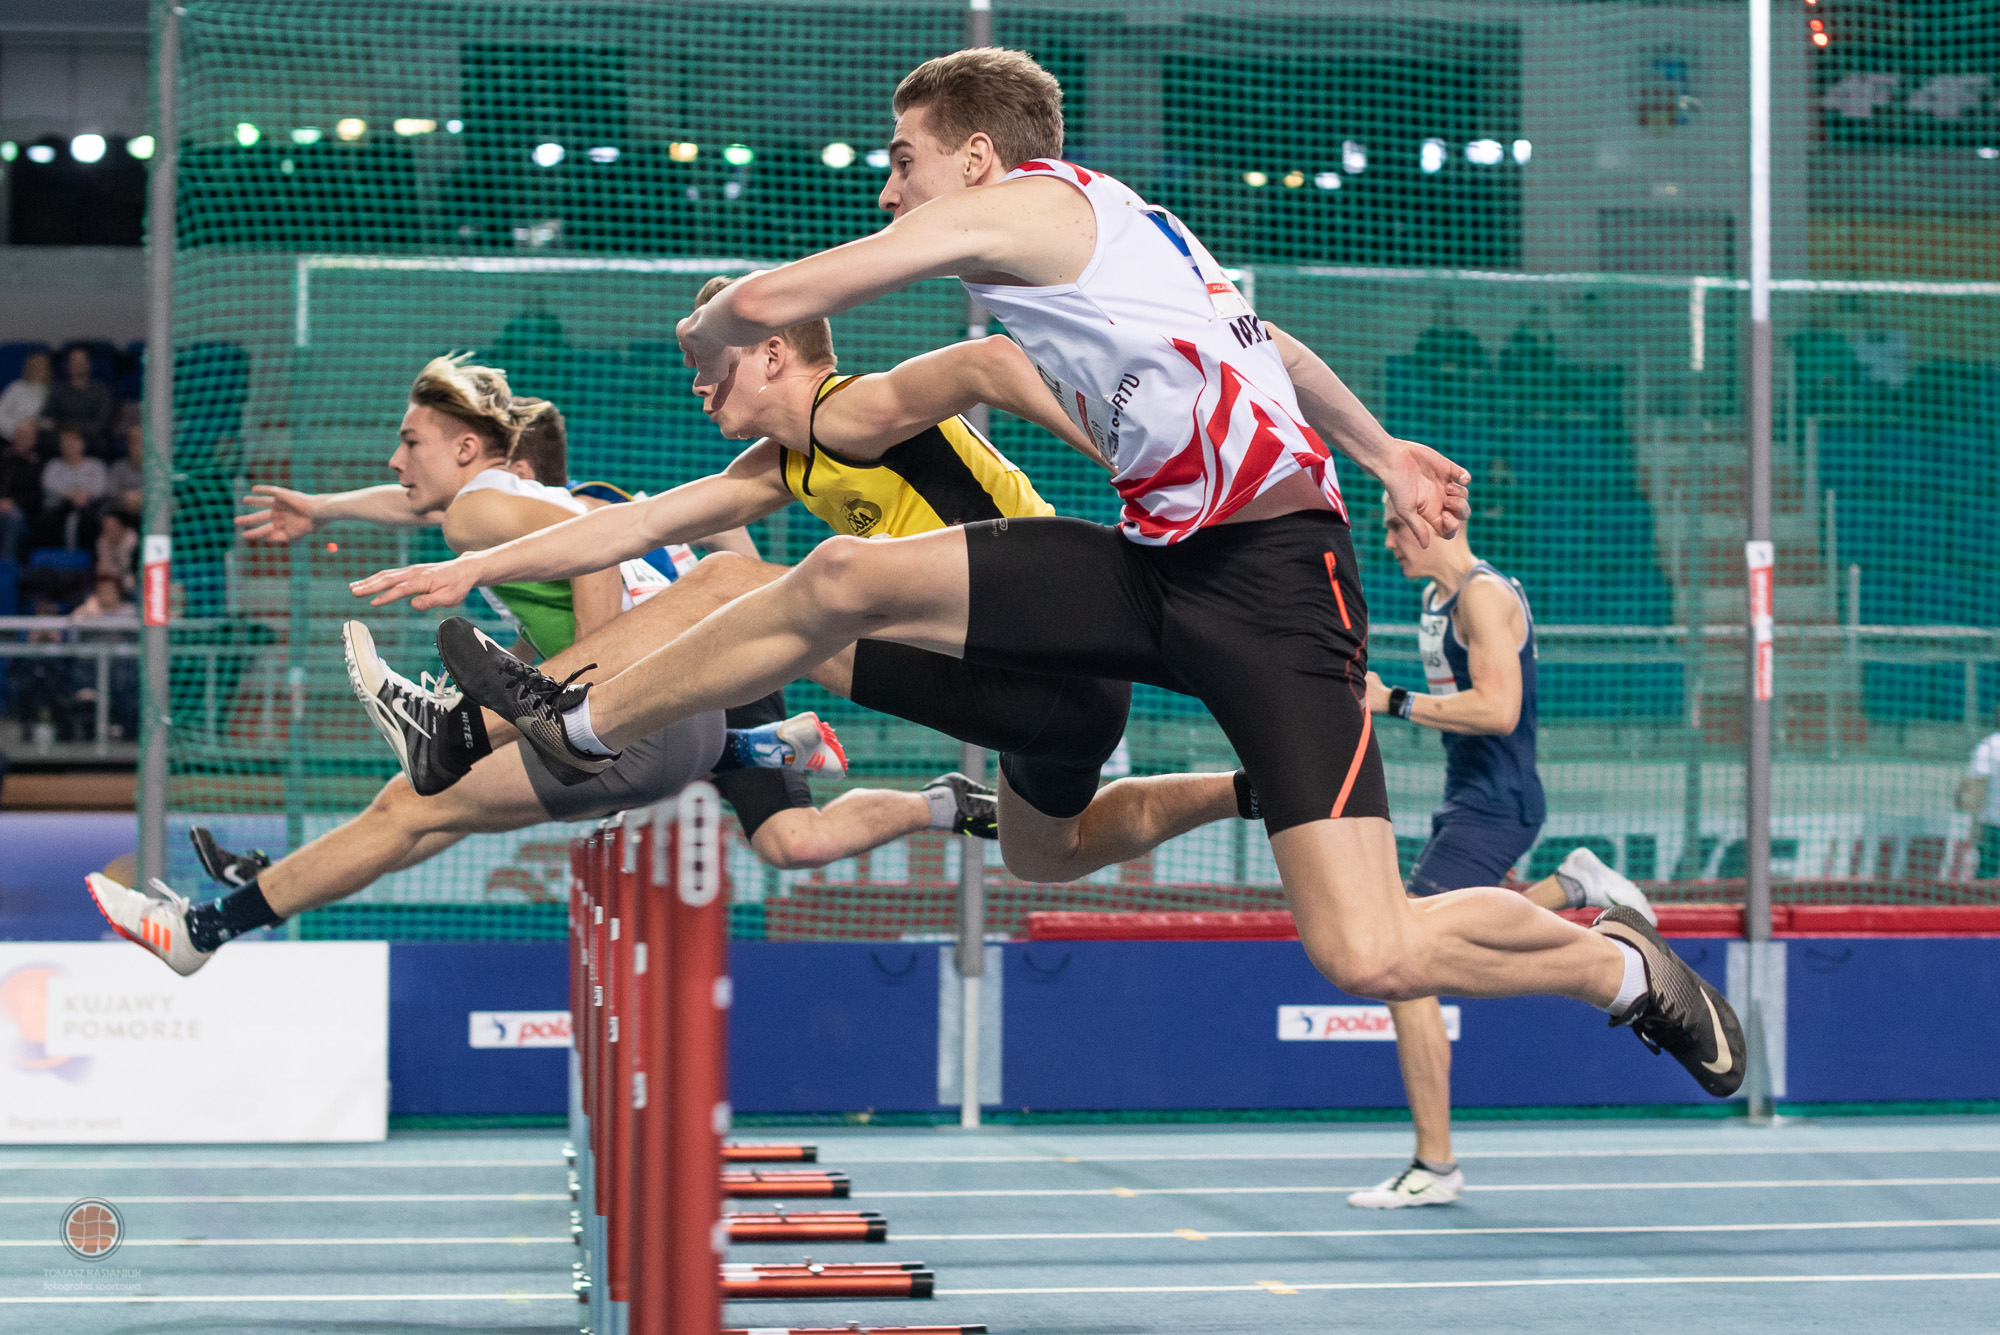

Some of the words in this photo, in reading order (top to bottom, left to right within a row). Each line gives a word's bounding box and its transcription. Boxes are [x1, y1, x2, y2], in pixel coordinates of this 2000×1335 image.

[461, 711, 474, 749] HI-TEC
[63, 994, 176, 1014] KUJAWY
[63, 1020, 201, 1040] POMORZE
